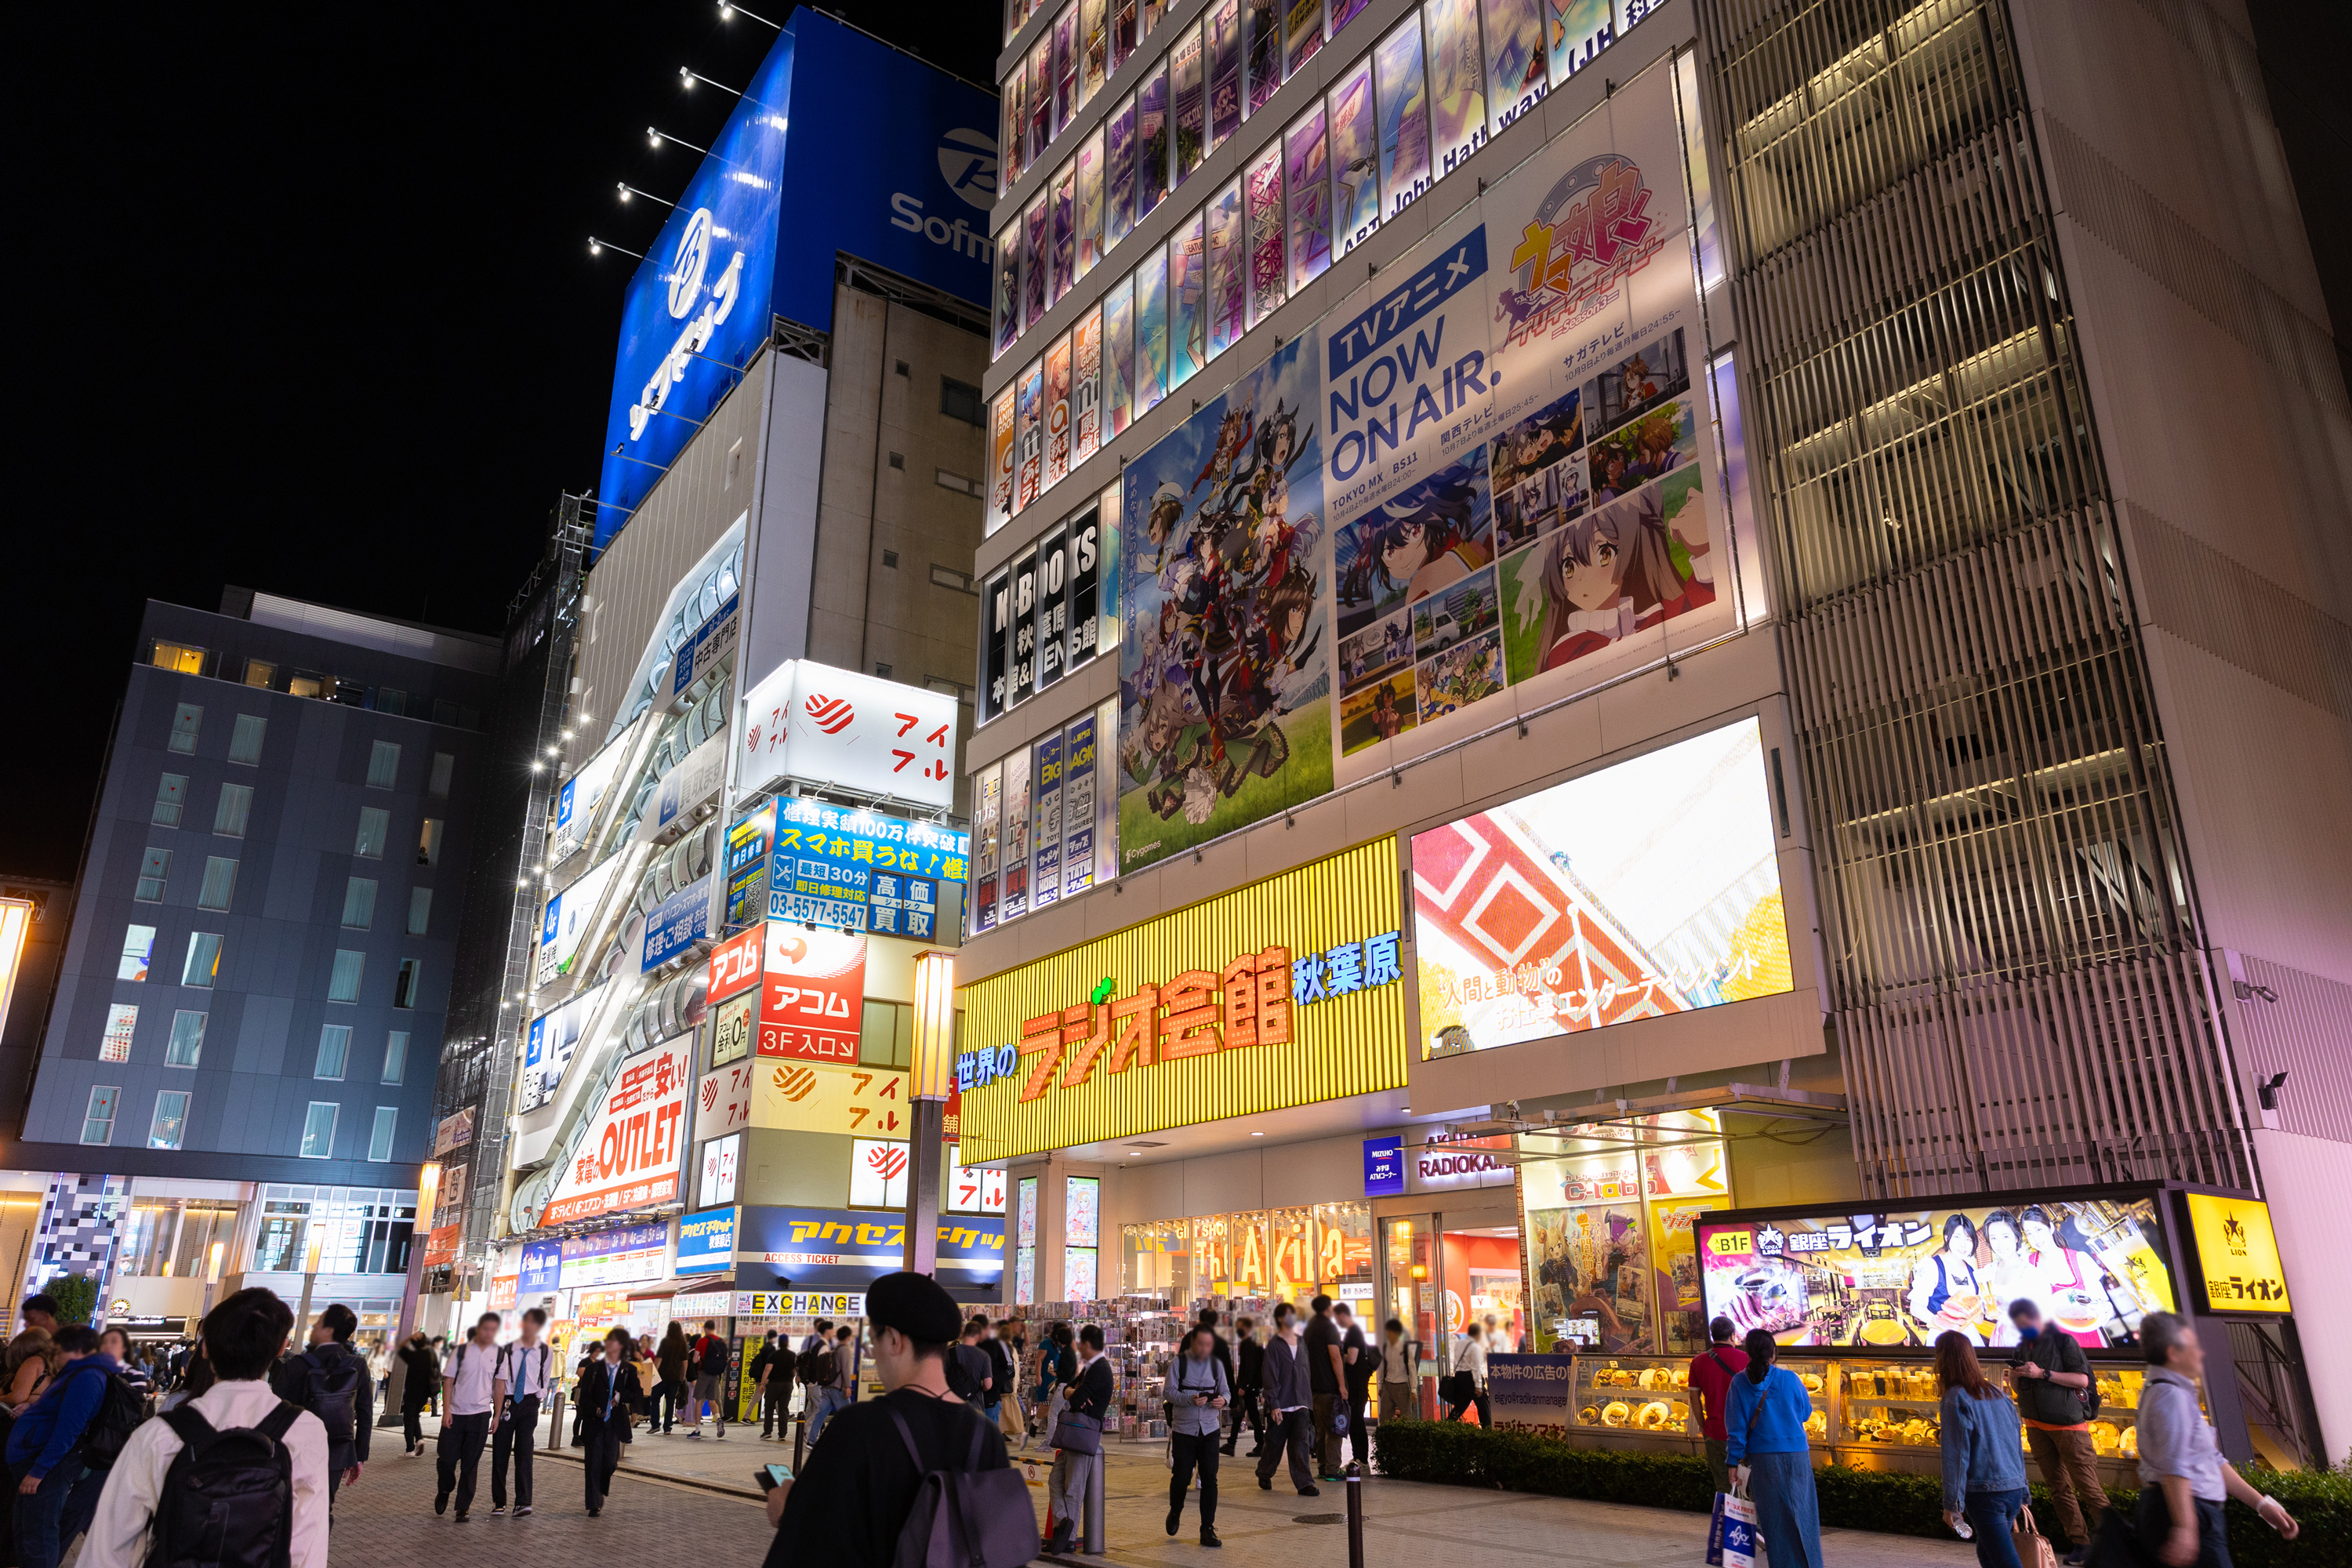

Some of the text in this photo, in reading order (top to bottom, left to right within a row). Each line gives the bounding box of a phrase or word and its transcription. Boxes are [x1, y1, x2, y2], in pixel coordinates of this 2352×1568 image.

[1510, 159, 1653, 296] ウマ娘
[1339, 247, 1470, 363] TVアニメ
[630, 252, 745, 441] ソフマップ
[1563, 321, 1625, 368] サガテレビ
[1330, 314, 1445, 435] NOW
[1330, 349, 1501, 481] ON AIR.
[1440, 403, 1494, 446] 関西テレビ
[1332, 452, 1418, 511] TOKYO MX BS11
[695, 615, 738, 670] 中古専門店
[680, 757, 724, 808] 買取ます
[783, 801, 956, 853] 修理実績100万件突破
[731, 837, 764, 870] 即日修理
[1131, 838, 1162, 859] Cygames
[770, 892, 865, 928] 03-5577-5547
[795, 880, 866, 902] 即日修理対応
[710, 938, 758, 994] アコム
[1292, 930, 1402, 1007] 秋葉原
[773, 985, 850, 1019] アコム
[1495, 949, 1760, 1030] お仕事エンターテインメント
[763, 1029, 837, 1056] 3F 入口
[1018, 945, 1293, 1103] ラジオ会館
[955, 1044, 1017, 1094] 世界の
[1371, 1149, 1394, 1159] MIZUHO
[1370, 1171, 1397, 1181] ATMコーナー
[1068, 1232, 1095, 1240] あみあみ
[1720, 1235, 1748, 1251] B1F
[1788, 1221, 1933, 1252] 銀座ライオン
[2230, 1248, 2247, 1257] LION
[764, 1252, 840, 1265] ACCESS TICKET
[752, 1294, 860, 1311] EXCHANGE
[2208, 1276, 2284, 1301] 銀座ライオン
[1740, 1506, 1755, 1515] FREE
